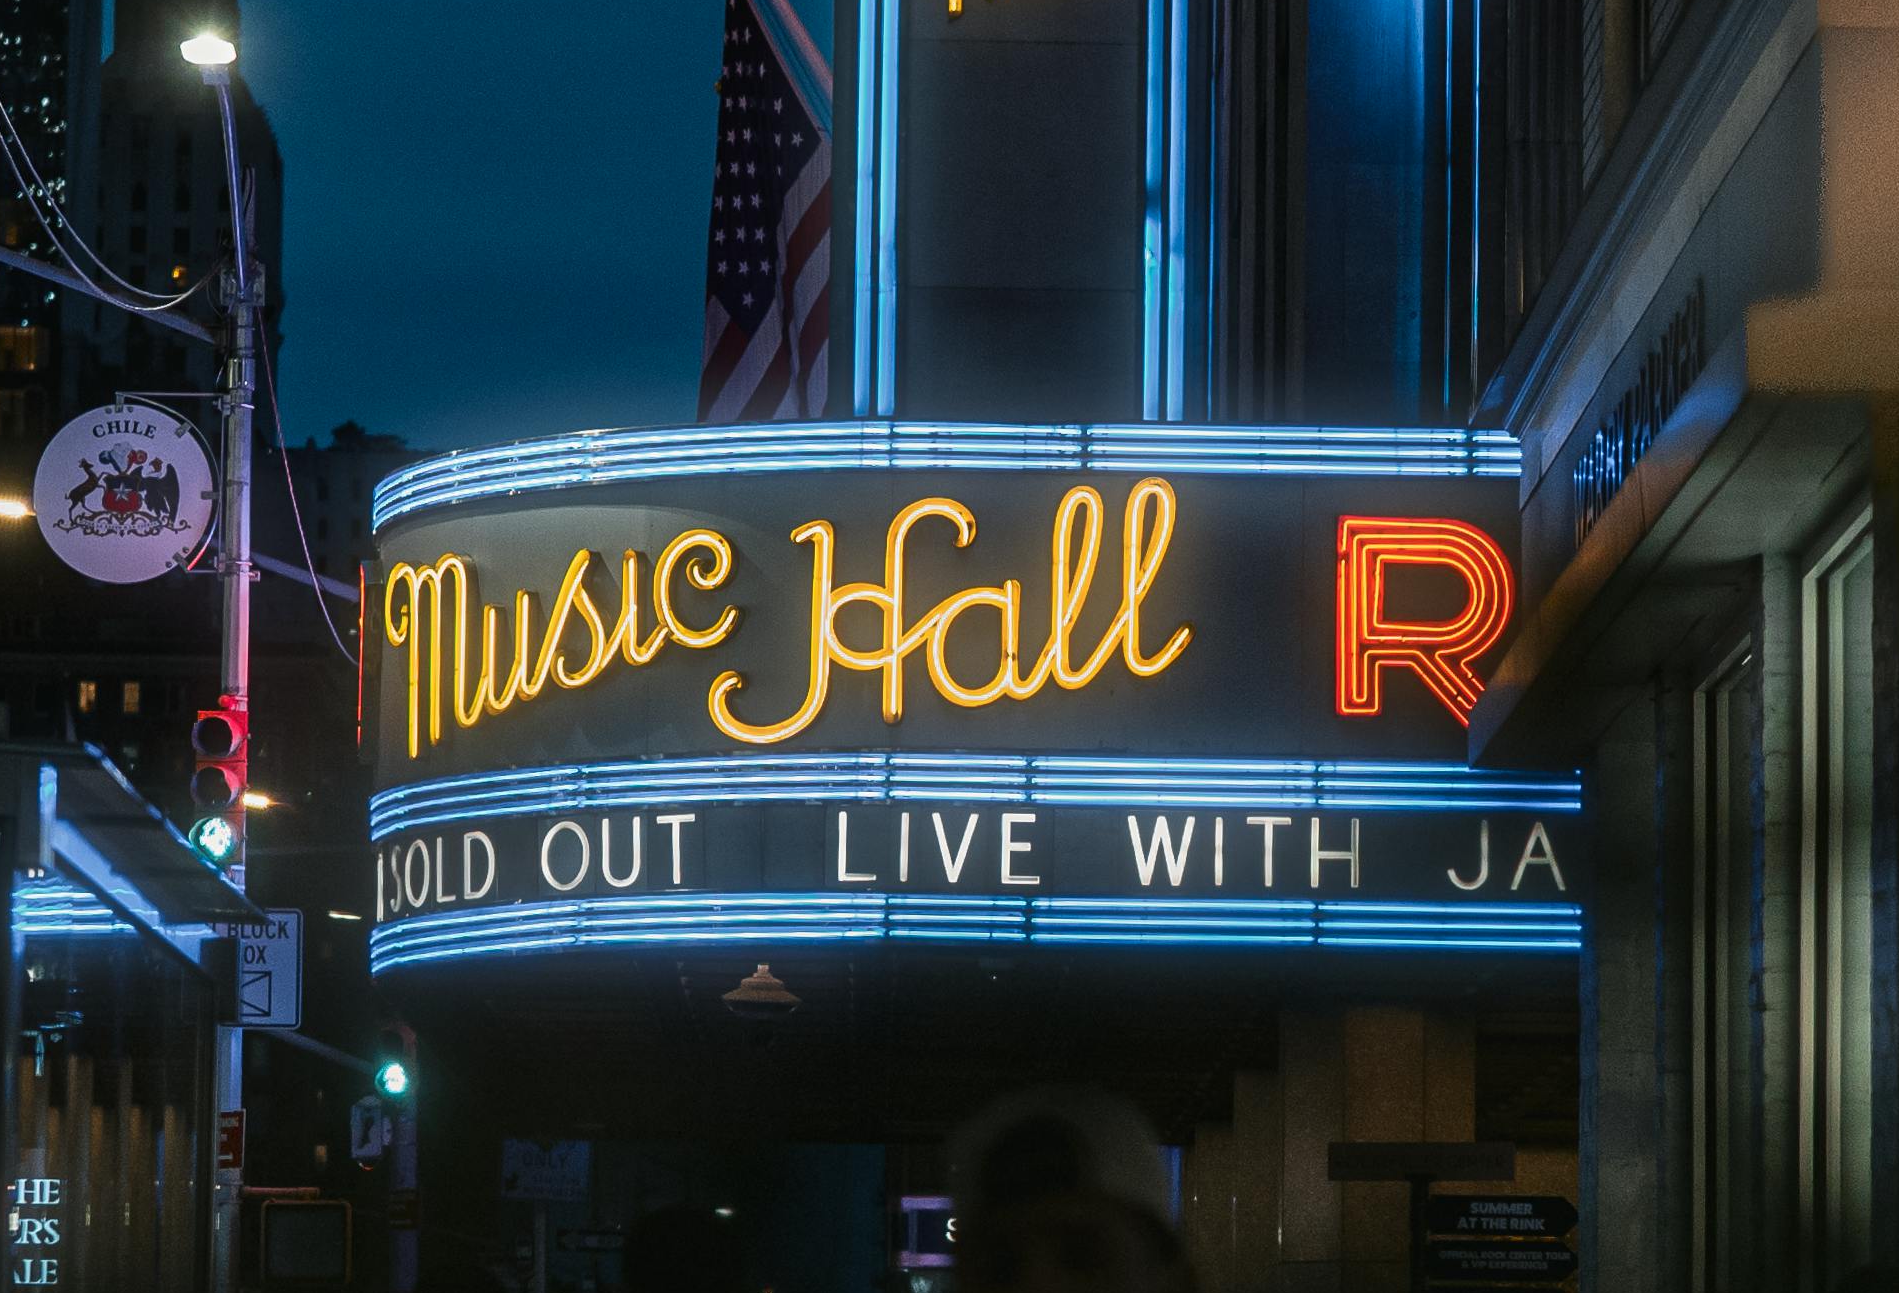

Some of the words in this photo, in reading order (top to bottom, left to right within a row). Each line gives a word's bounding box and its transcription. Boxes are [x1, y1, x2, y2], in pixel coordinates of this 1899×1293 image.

[92, 420, 157, 439] CHILE
[386, 527, 740, 759] Music
[710, 478, 1195, 744] Hall
[1337, 515, 1515, 729] R
[390, 830, 496, 913] SOLD
[540, 813, 697, 891] OUT
[837, 810, 1041, 885] LIVE
[1127, 814, 1361, 889] WITH
[1447, 817, 1567, 892] JA
[227, 920, 289, 939] BLOCK
[243, 945, 267, 964] OX
[13, 1178, 61, 1205] HE
[1469, 1202, 1533, 1215] SUMMER
[12, 1216, 61, 1245] R'S
[1456, 1217, 1477, 1230] AT
[1480, 1217, 1508, 1230] THE
[1508, 1217, 1545, 1231] RINK
